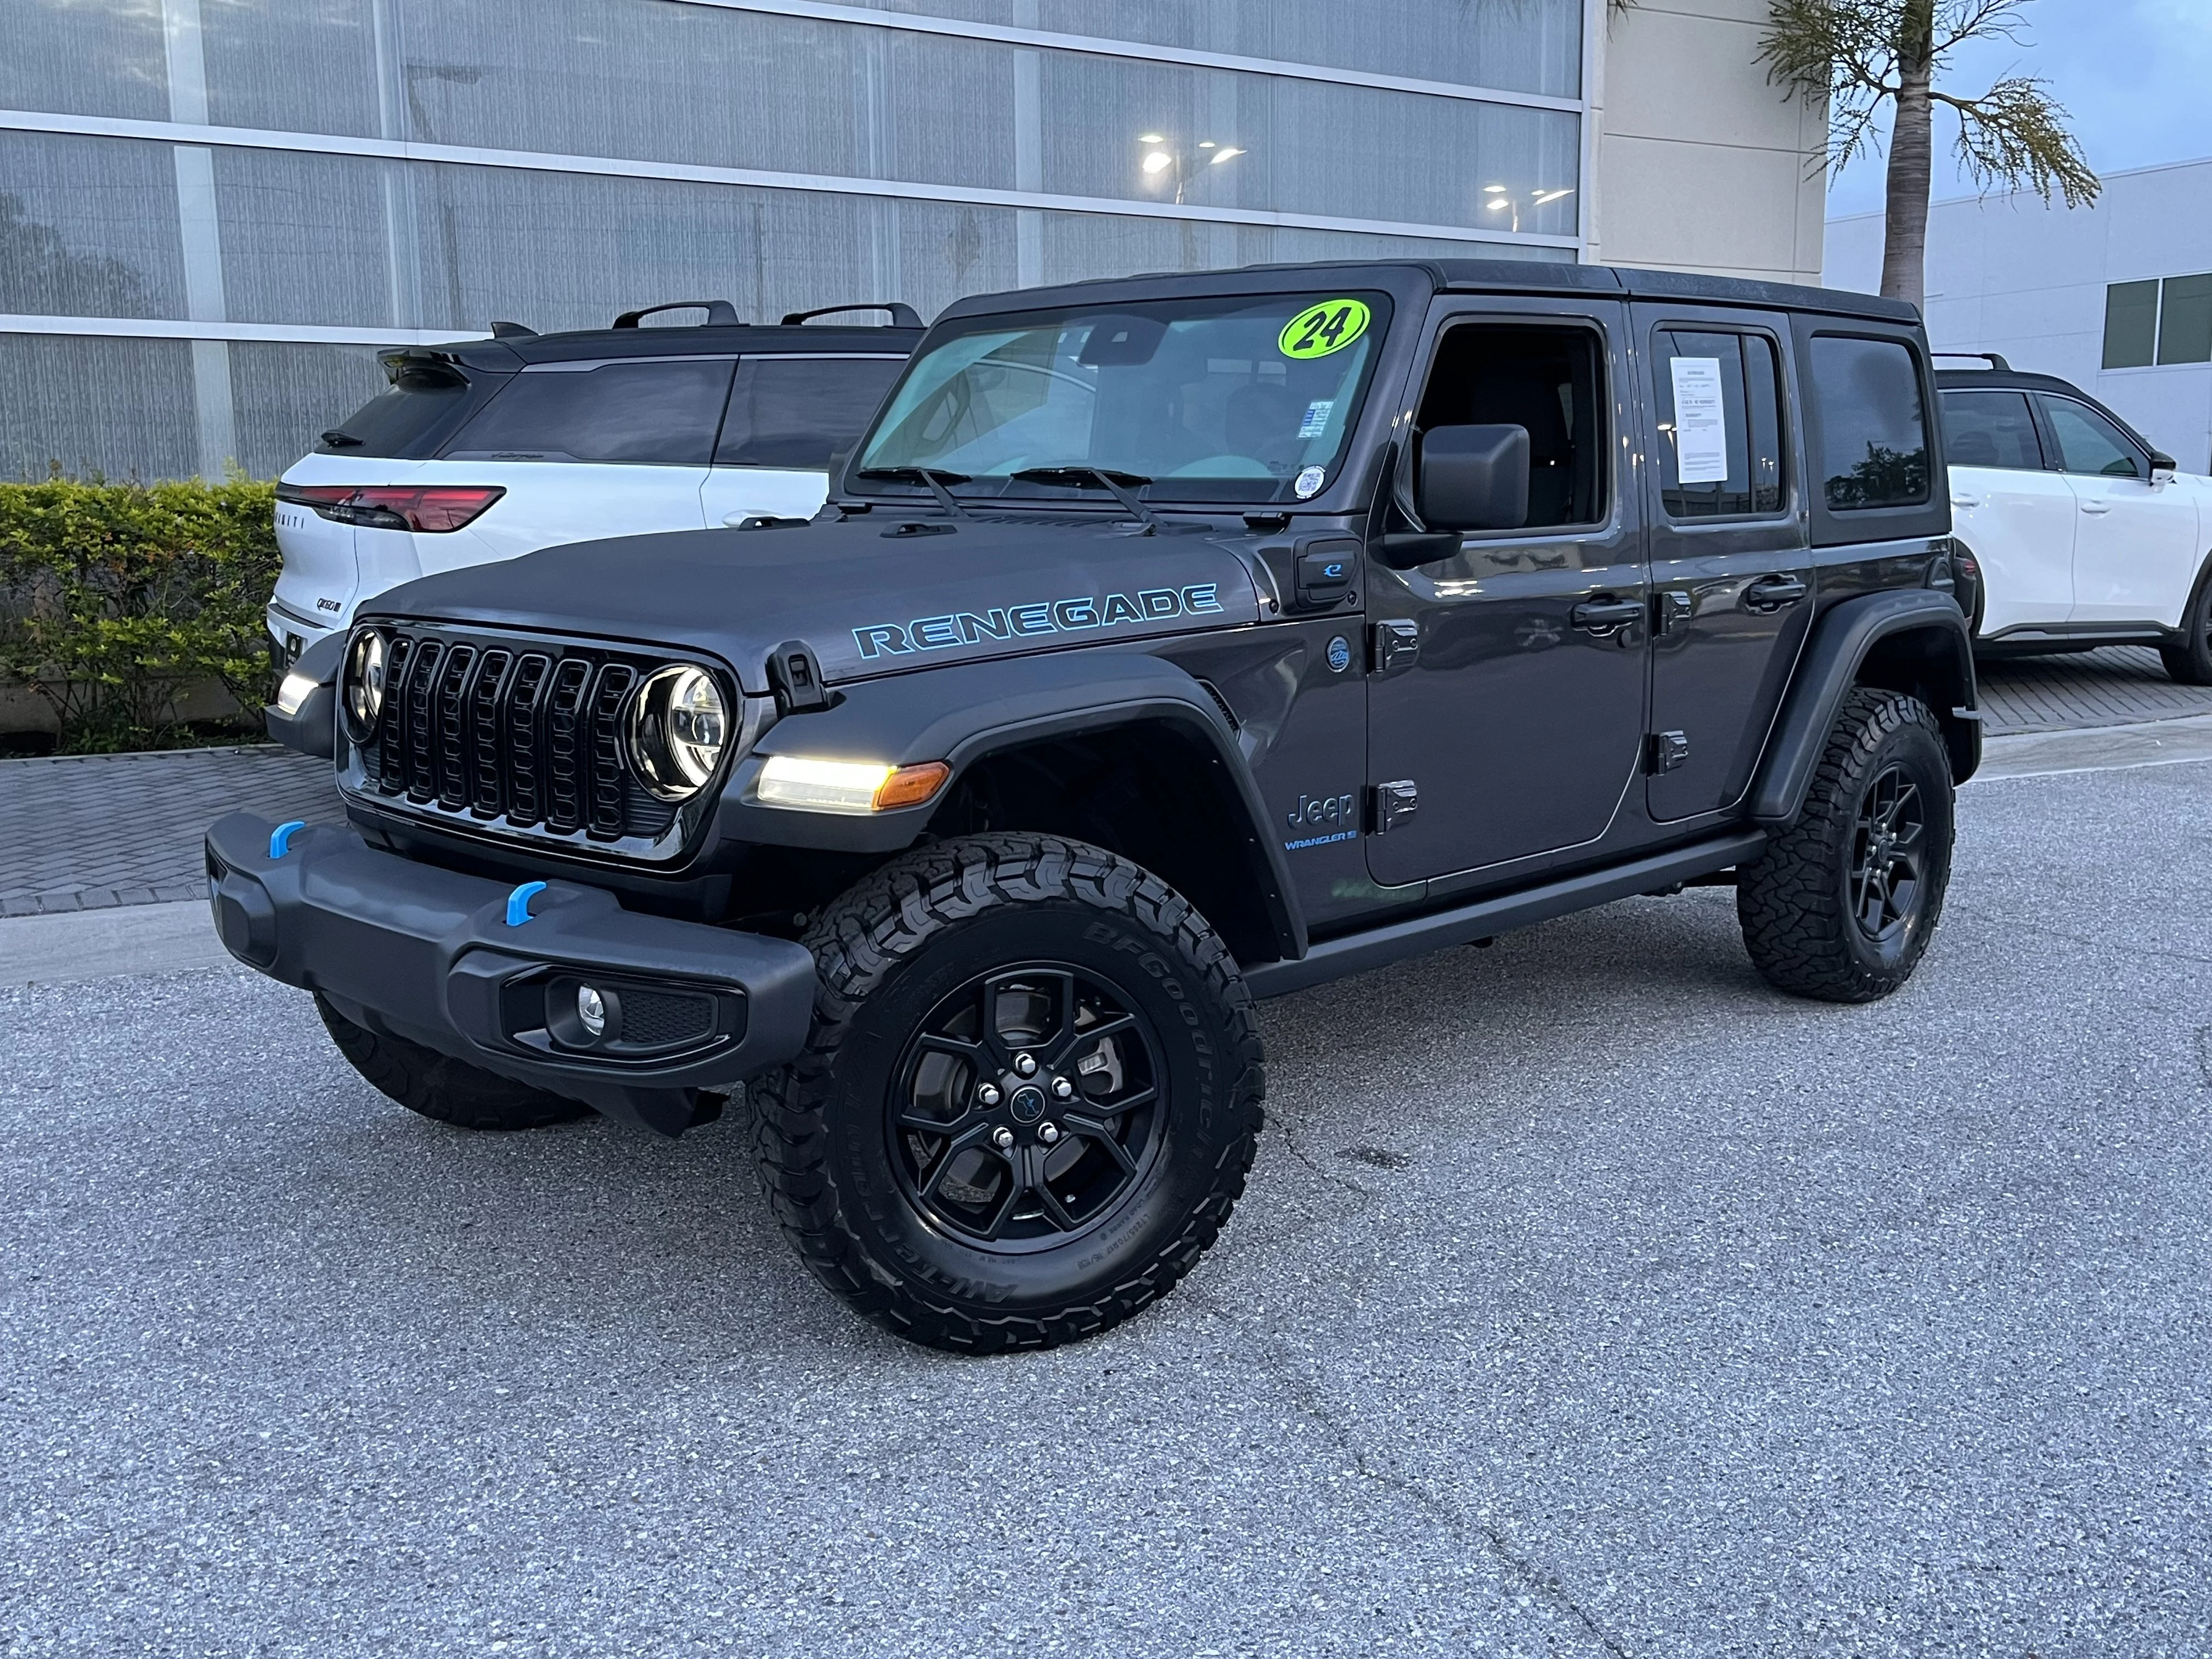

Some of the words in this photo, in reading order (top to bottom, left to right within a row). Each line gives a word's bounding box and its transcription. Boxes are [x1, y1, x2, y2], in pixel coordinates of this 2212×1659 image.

[1293, 306, 1352, 352] 24
[851, 582, 1224, 659] RENEGADE
[1288, 794, 1355, 831] Jeep
[1284, 832, 1346, 851] WRANGLER
[1081, 922, 1213, 1159] BFGoodrich
